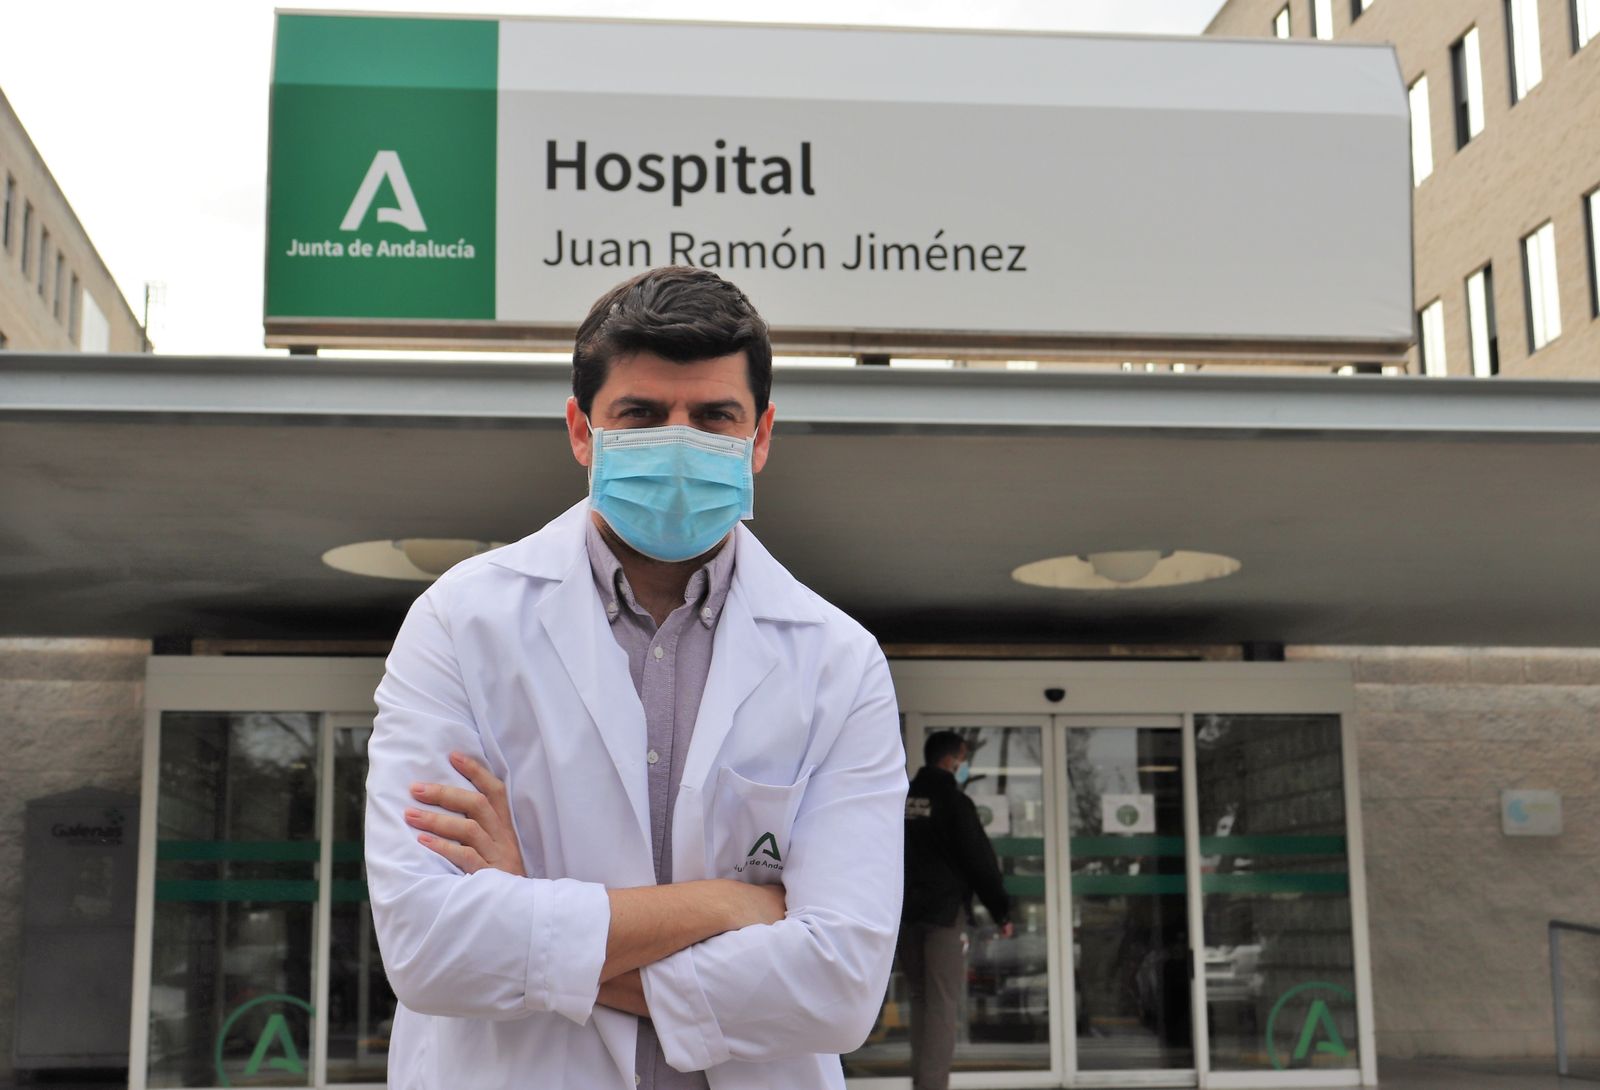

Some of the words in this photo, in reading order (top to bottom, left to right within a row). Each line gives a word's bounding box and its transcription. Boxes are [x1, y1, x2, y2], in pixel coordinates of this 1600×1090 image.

[546, 138, 816, 207] Hospital
[286, 238, 344, 257] Junta
[348, 238, 373, 257] de
[376, 238, 476, 259] Andalucía
[543, 229, 652, 267] Juan
[670, 227, 826, 269] Ramón
[842, 228, 1028, 272] Jiménez
[761, 859, 784, 871] Anda
